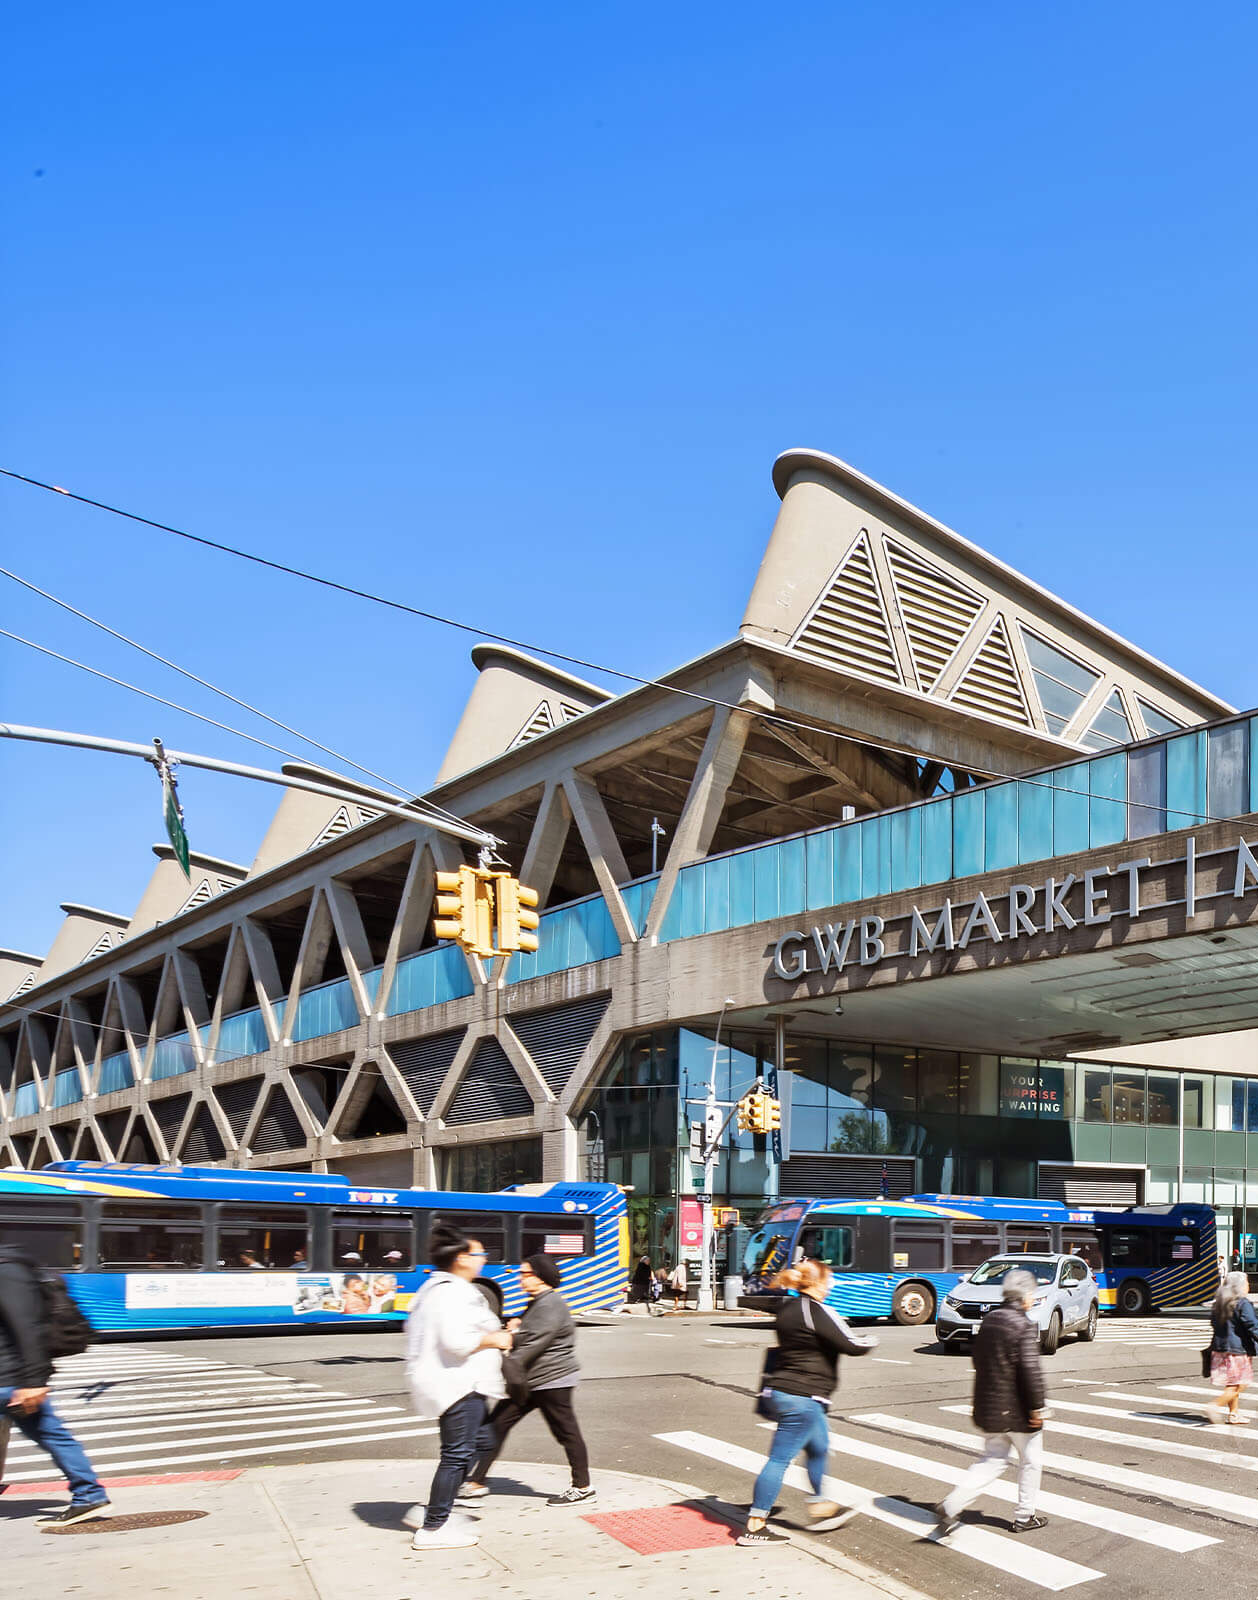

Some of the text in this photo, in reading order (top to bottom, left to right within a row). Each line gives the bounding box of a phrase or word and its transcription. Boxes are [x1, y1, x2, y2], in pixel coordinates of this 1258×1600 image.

[773, 914, 886, 981] GWB
[908, 856, 1152, 958] MARKET
[1008, 1100, 1060, 1113] WAITING
